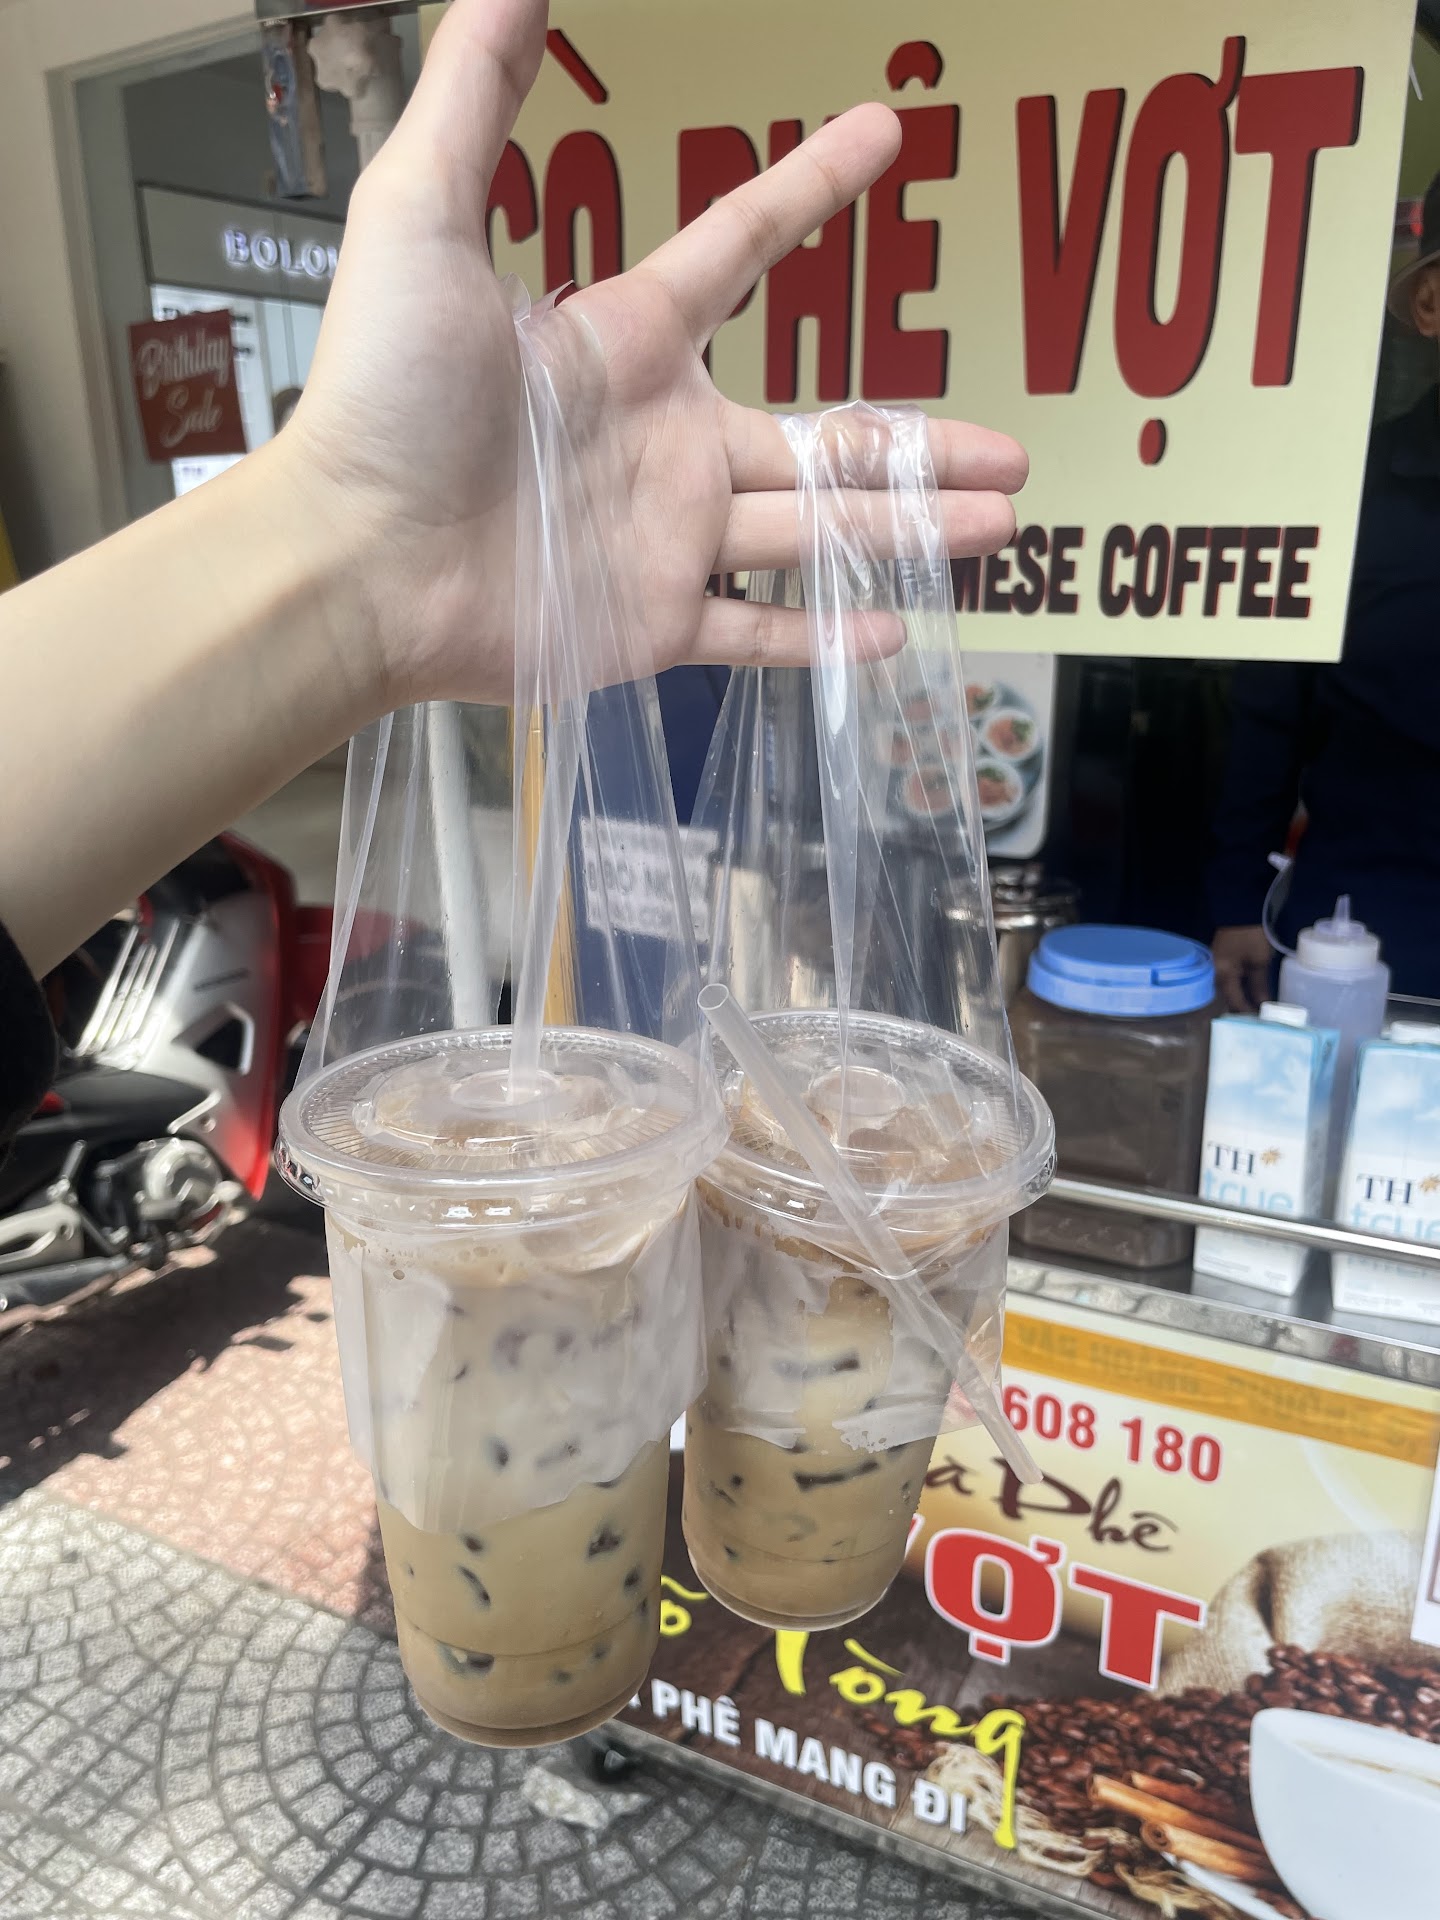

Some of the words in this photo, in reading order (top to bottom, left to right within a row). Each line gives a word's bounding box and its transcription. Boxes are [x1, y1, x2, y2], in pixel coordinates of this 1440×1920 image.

[1016, 36, 1365, 466] VỢT
[139, 328, 230, 398] Birthday
[159, 386, 223, 448] Sale
[1099, 524, 1319, 618] COFFEE
[1207, 1141, 1255, 1175] TH
[1356, 1174, 1416, 1205] TH
[1002, 1385, 1096, 1450] 608
[1120, 1416, 1221, 1482] 180
[923, 1456, 977, 1496] à
[991, 1457, 1179, 1552] Phê
[660, 1574, 709, 1637] õ
[906, 1513, 1204, 1690] ỢT
[651, 1678, 741, 1747] PHÊ
[754, 1717, 898, 1809] MANG
[910, 1777, 968, 1835] ĐI
